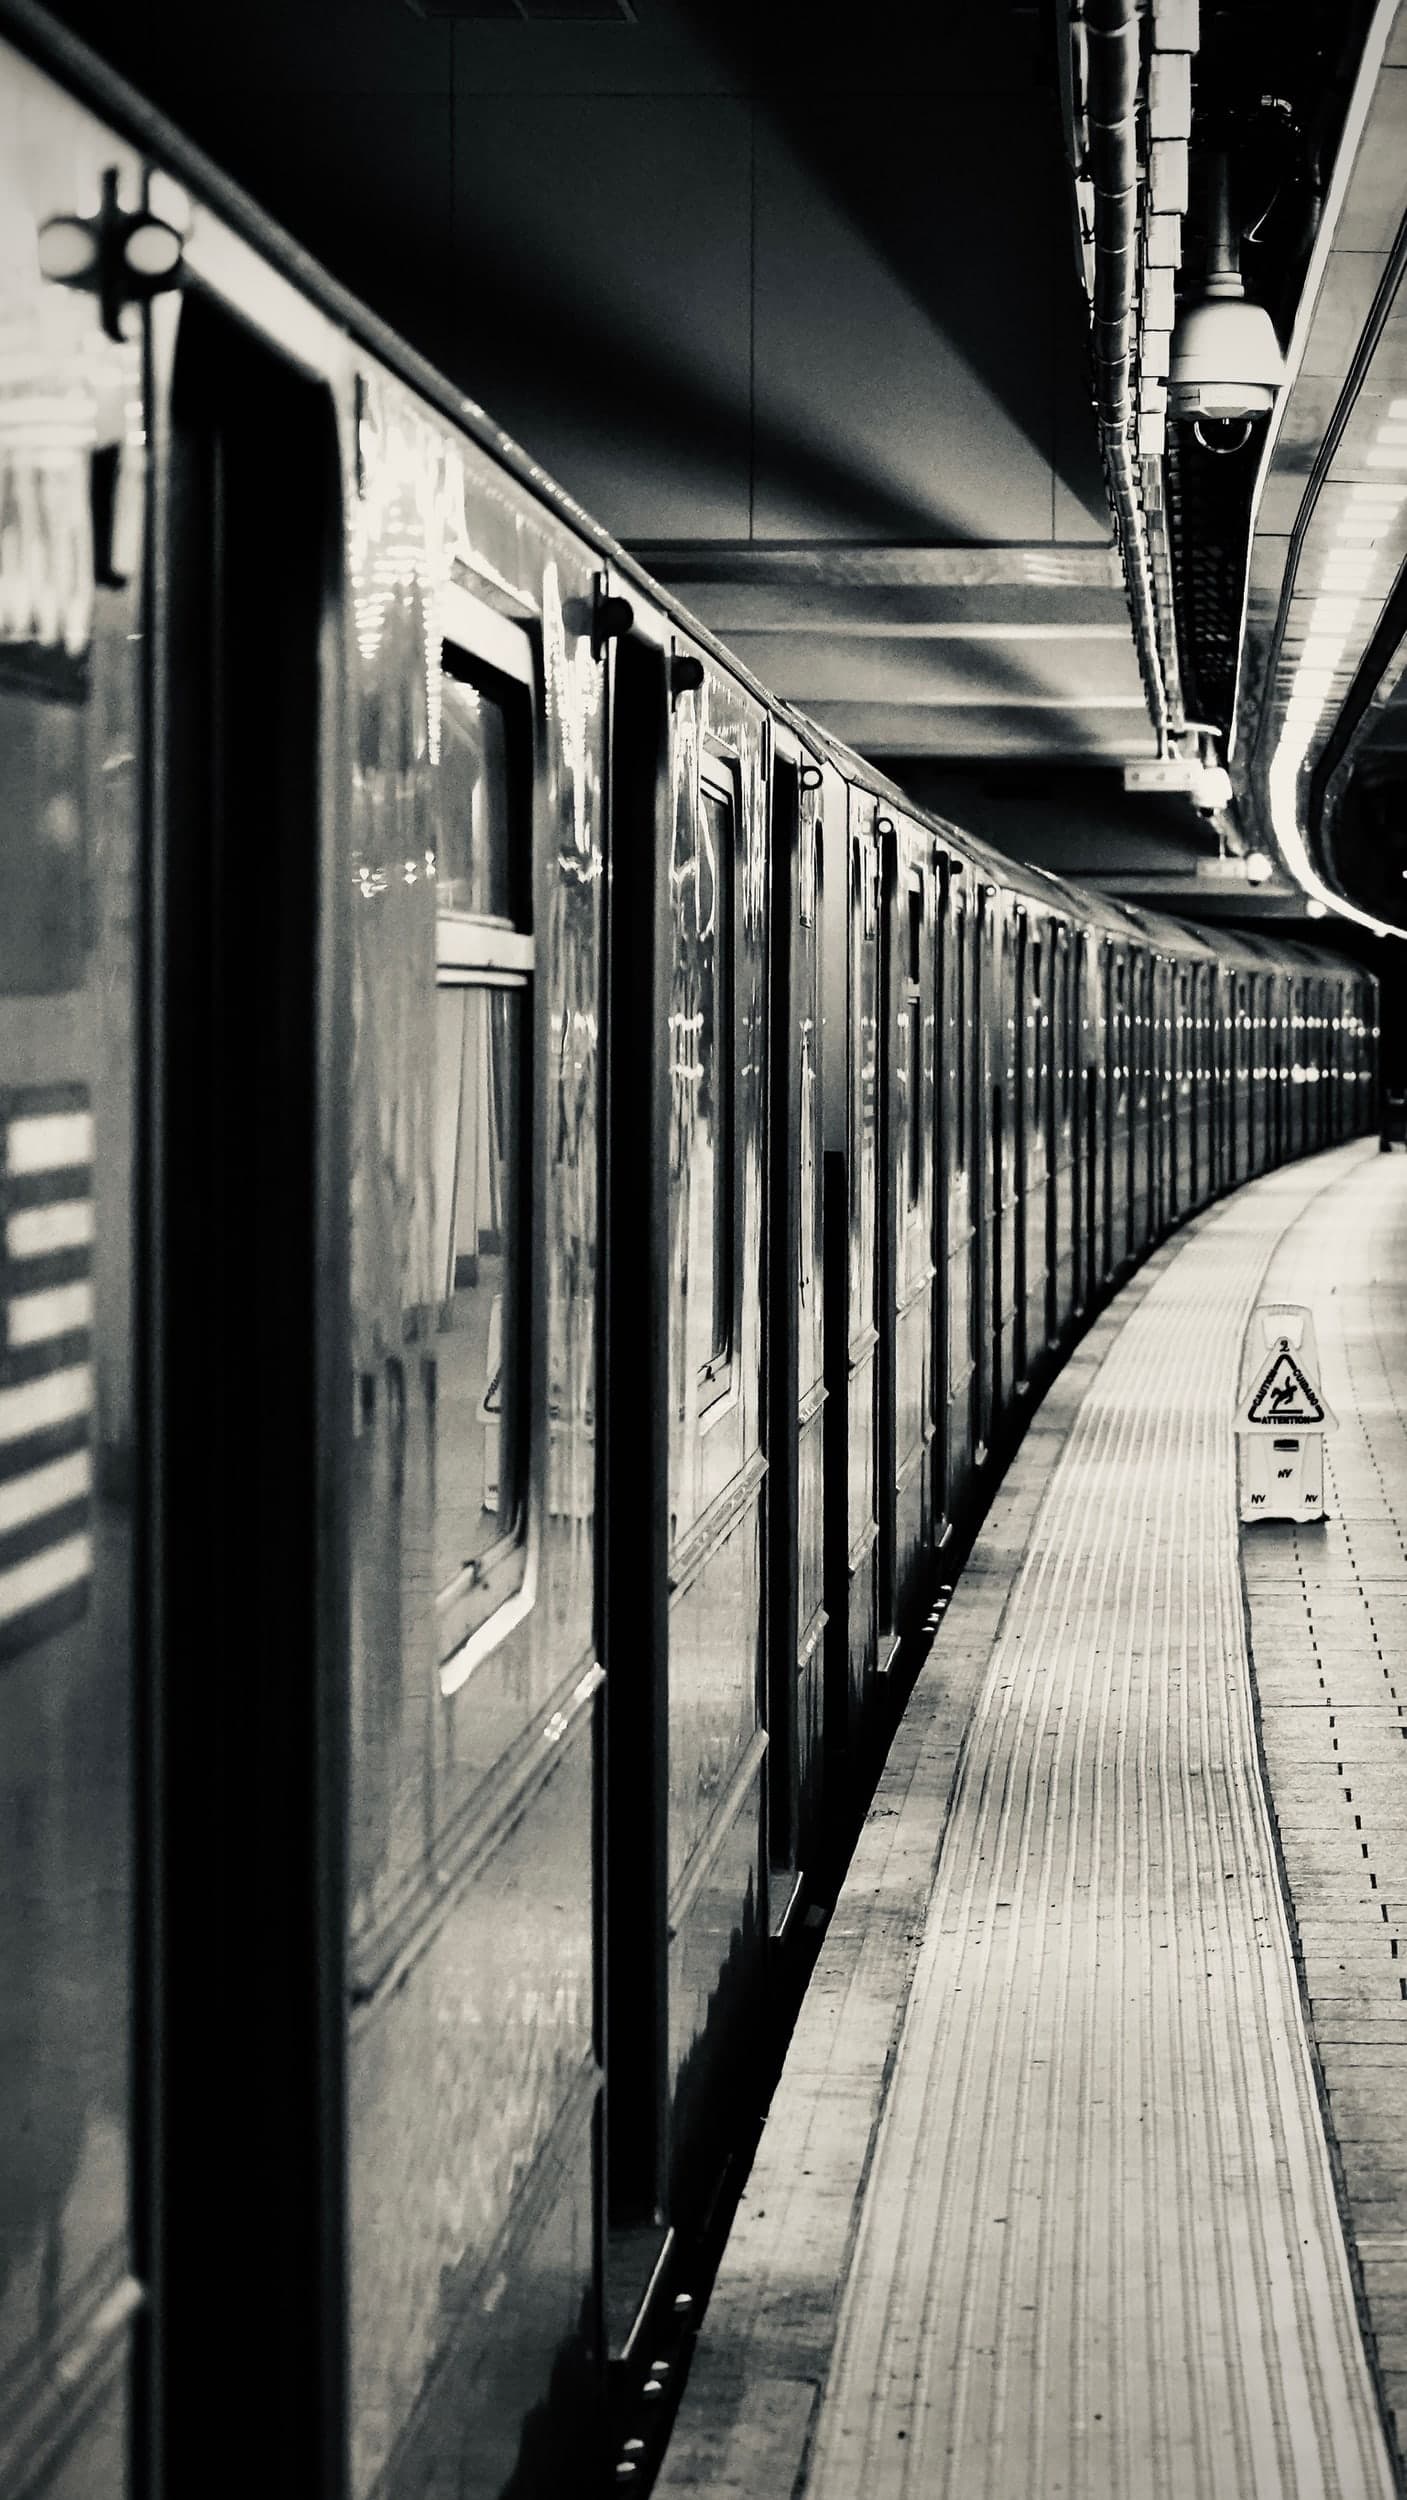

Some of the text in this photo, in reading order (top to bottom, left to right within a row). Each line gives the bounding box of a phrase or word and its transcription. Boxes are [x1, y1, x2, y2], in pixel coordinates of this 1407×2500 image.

[1253, 1369, 1278, 1407] CAUTION
[1293, 1369, 1319, 1406] CUIDADO
[1261, 1416, 1311, 1424] ATTENTION
